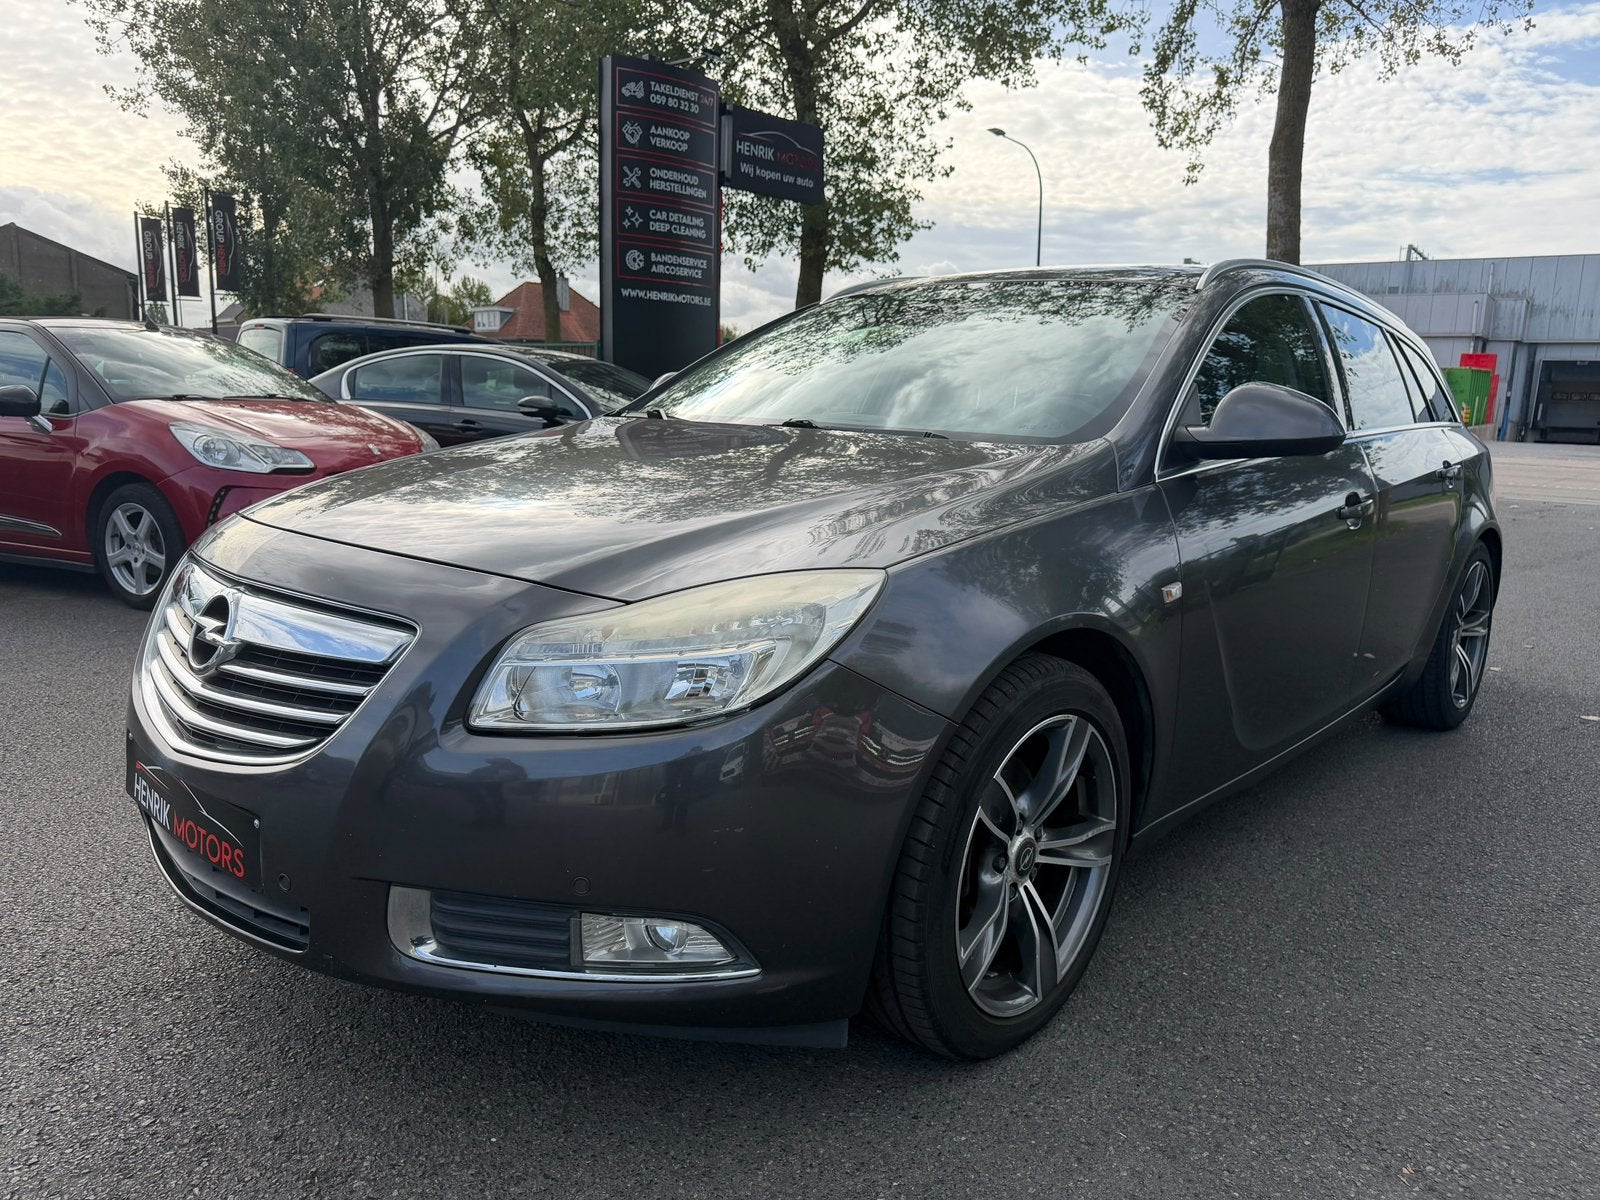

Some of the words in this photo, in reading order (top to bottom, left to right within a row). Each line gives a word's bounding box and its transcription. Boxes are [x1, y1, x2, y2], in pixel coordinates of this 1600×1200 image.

[650, 81, 699, 102] TAKELDIENST
[650, 93, 667, 105] 059
[667, 97, 679, 108] 80
[680, 100, 690, 111] 32
[690, 103, 699, 114] 30
[650, 125, 690, 141] AANKOOP
[650, 137, 688, 152] VERKOOP
[736, 140, 775, 161] HENRIK
[650, 167, 699, 185] ONDERHOUD
[740, 161, 754, 177] Wij
[756, 166, 781, 180] kopen
[783, 174, 795, 183] uw
[796, 177, 814, 188] auto
[650, 180, 707, 199] HERSTELLINGEN
[214, 209, 225, 243] GROUP
[649, 209, 668, 222] CAR
[668, 212, 704, 227] DETAILING
[175, 221, 185, 249] HENRIK
[649, 222, 671, 233] DEEP
[671, 224, 706, 239] CLEANING
[143, 230, 154, 260] GROUP
[217, 244, 228, 276] HENRIK
[651, 253, 708, 269] BANDENSERVICE
[651, 265, 702, 279] AIRCOSERVICE
[621, 288, 712, 306] WWW.HENRIKMOTORS.BE
[134, 772, 171, 830] HENRIK
[173, 810, 245, 878] MOTORS
